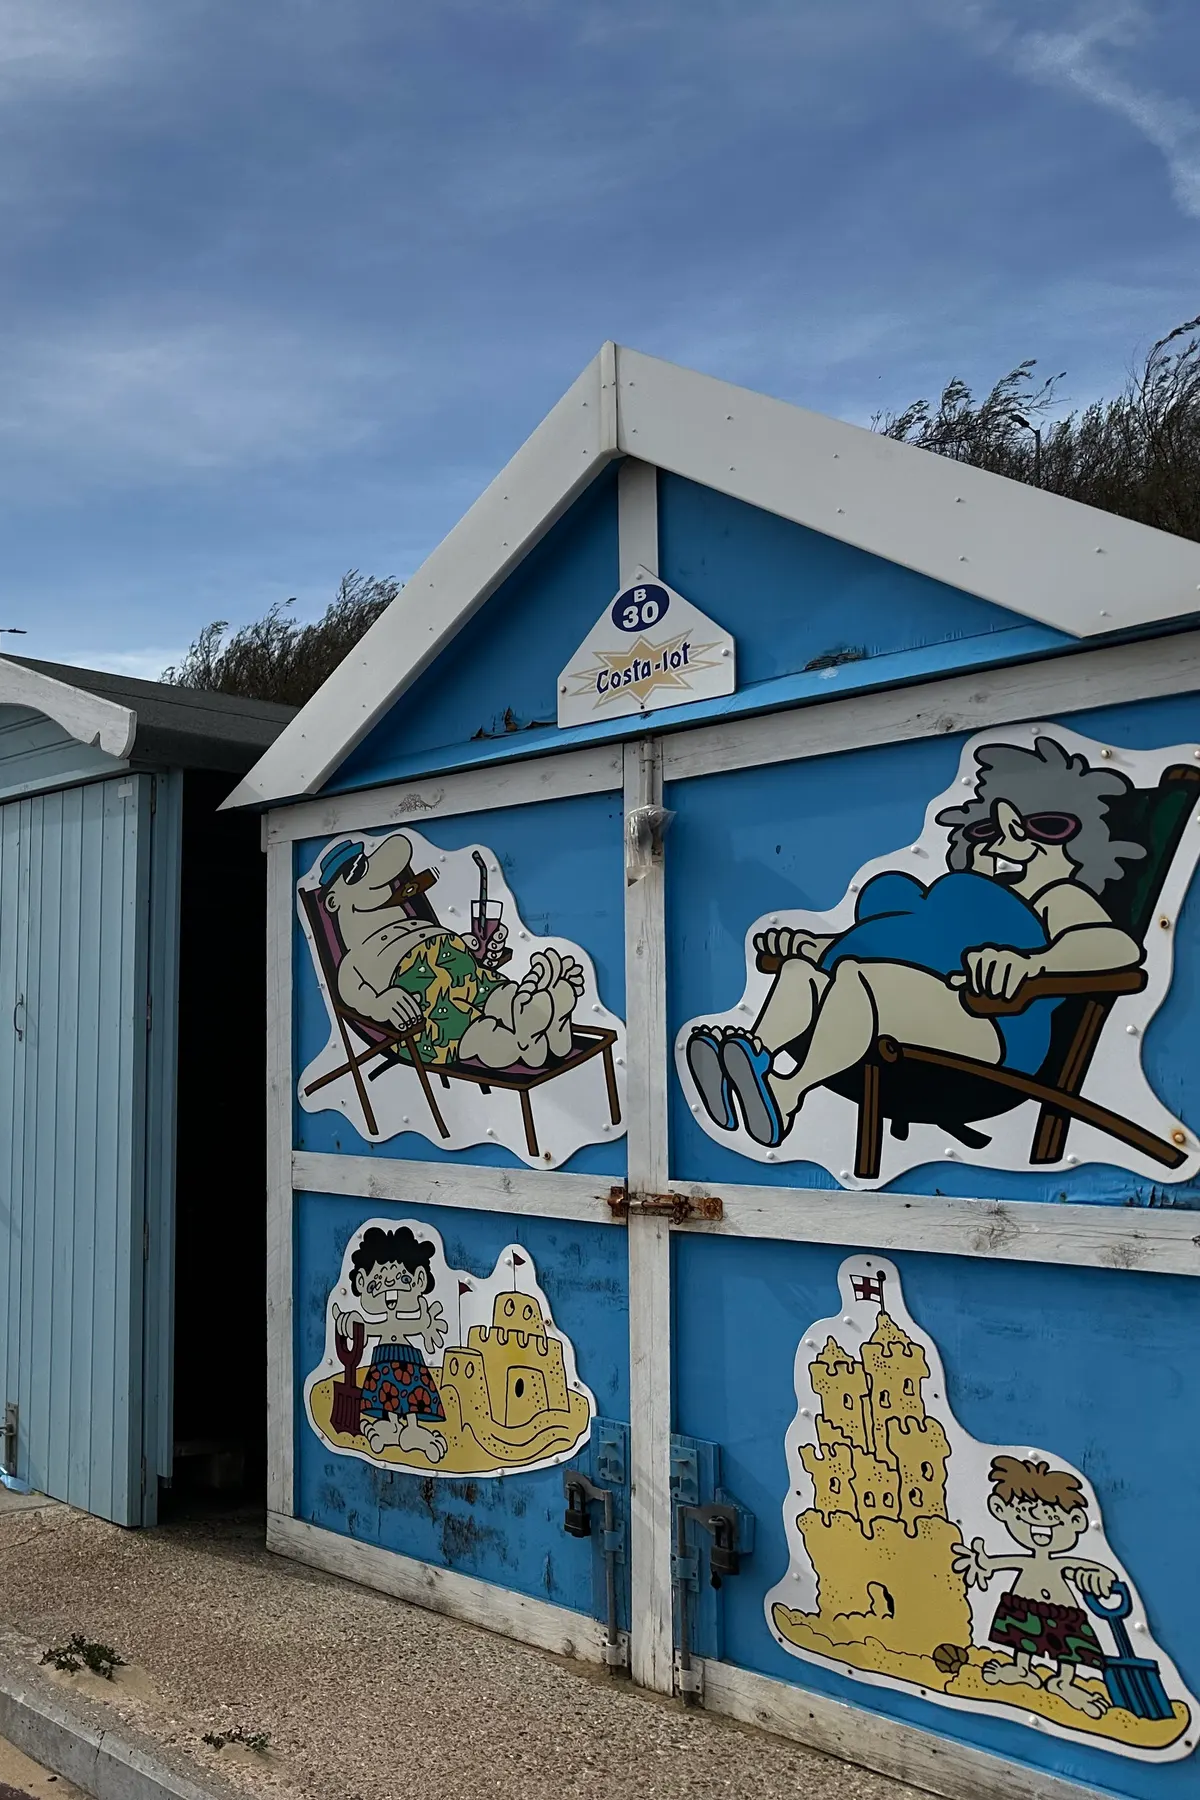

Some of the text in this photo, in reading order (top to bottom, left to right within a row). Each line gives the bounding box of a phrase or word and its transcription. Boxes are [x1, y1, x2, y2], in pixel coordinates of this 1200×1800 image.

[634, 588, 647, 603] B
[622, 600, 659, 629] 30
[596, 642, 691, 694] Costa-lot
